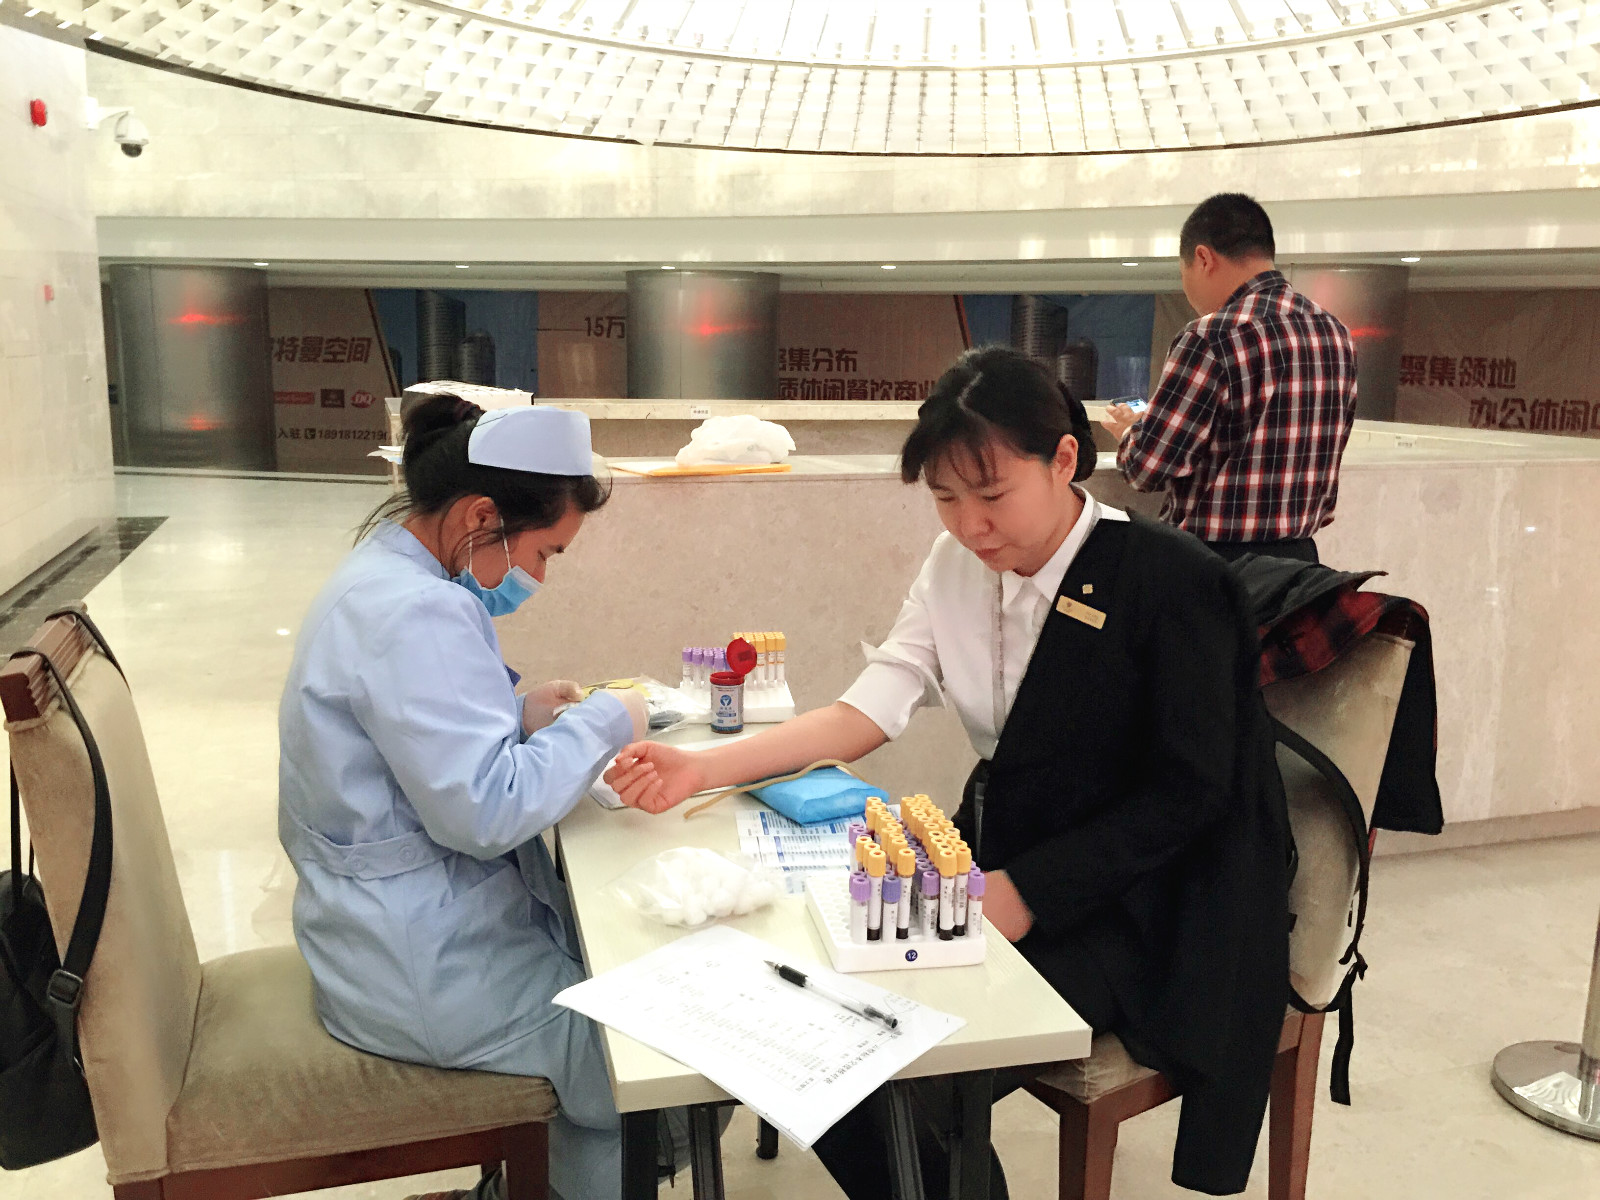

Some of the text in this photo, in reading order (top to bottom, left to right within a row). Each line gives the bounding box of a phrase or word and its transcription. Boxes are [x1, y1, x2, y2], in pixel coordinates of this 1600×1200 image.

[585, 315, 625, 338] 15万
[267, 336, 373, 363] 特曼空间
[1399, 354, 1517, 389] 聚集领地
[906, 951, 918, 960] 12
